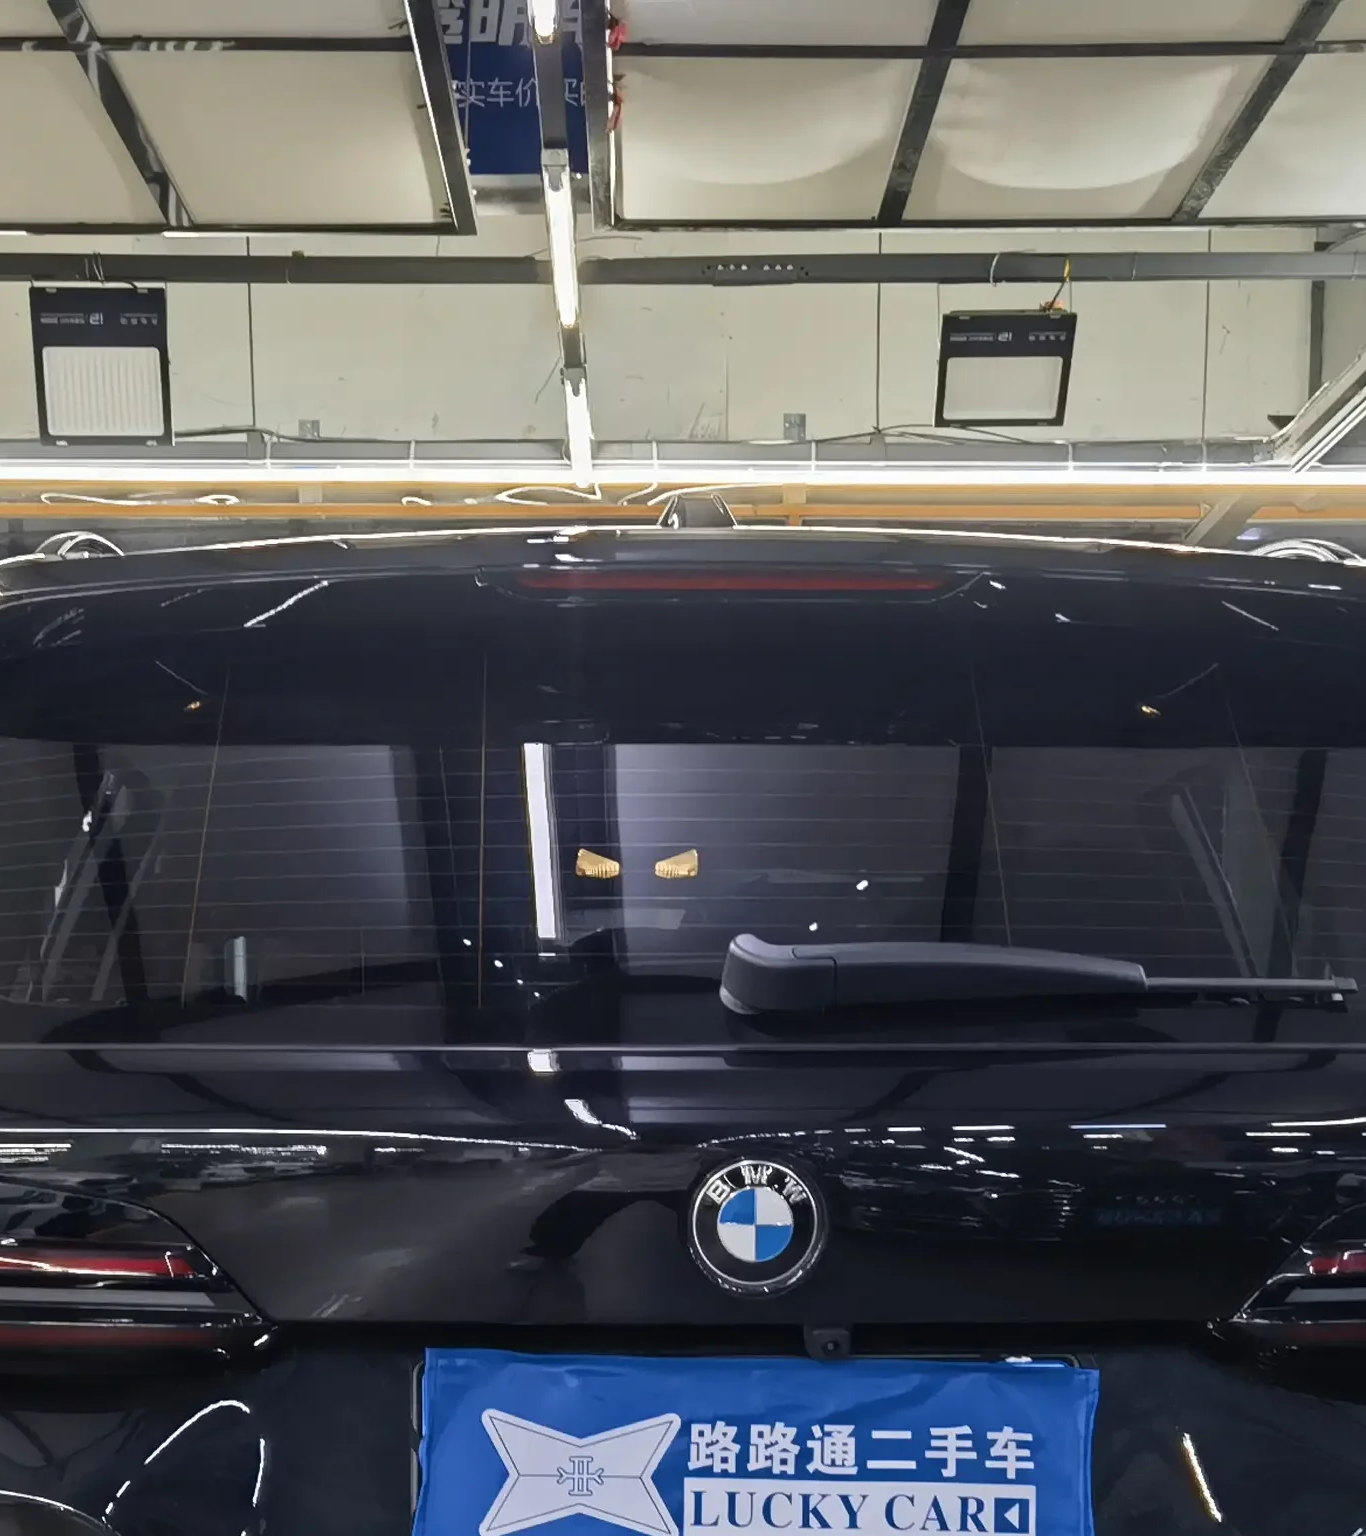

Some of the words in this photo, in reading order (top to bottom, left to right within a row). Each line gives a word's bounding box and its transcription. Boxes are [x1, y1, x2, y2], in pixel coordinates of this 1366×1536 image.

[706, 1165, 806, 1204] BMW
[687, 1421, 1034, 1480] 路路通二手车
[690, 1490, 869, 1530] LUCKY
[884, 1494, 988, 1532] CAR
